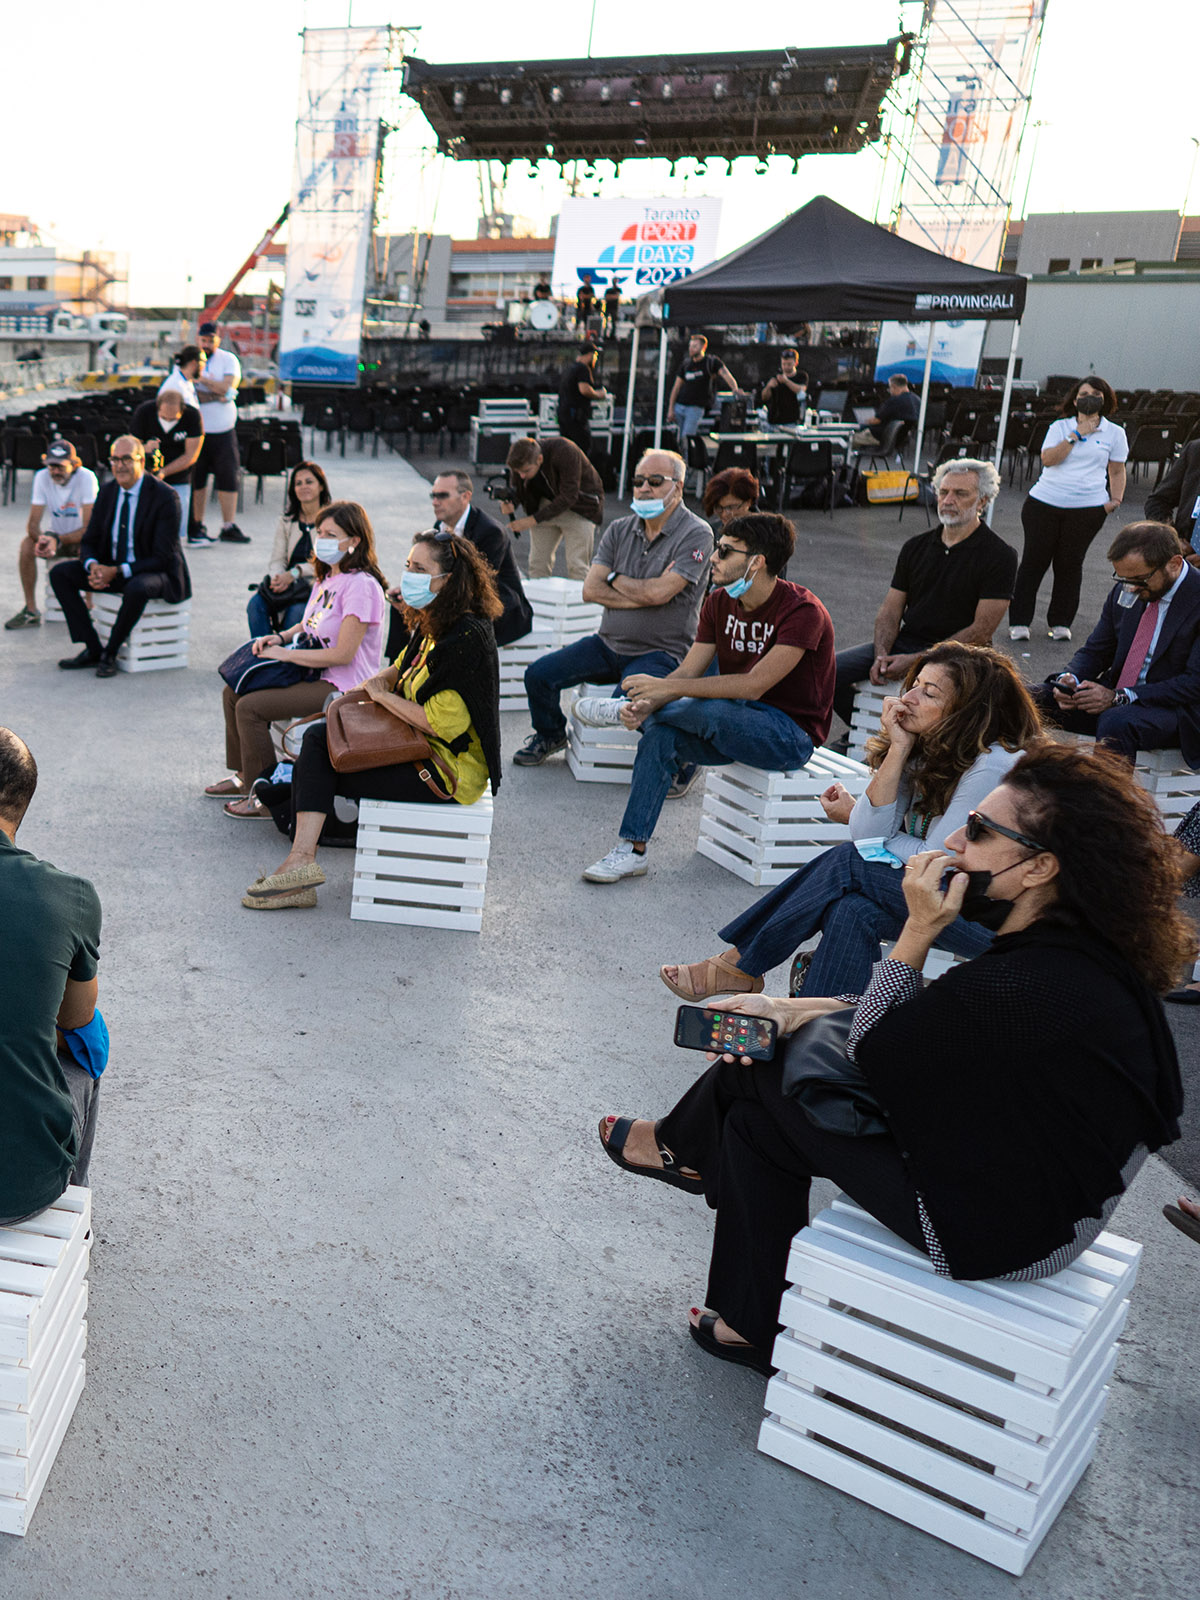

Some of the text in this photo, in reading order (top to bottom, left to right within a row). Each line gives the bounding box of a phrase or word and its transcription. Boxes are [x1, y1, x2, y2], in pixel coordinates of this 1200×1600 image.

[644, 207, 700, 221] Taranto
[644, 223, 695, 241] PORT
[641, 245, 690, 263] DAYS
[639, 267, 686, 285] 2021
[931, 294, 1014, 309] PROVINCIALI
[724, 614, 774, 642] FITCH
[730, 638, 765, 654] 1892
